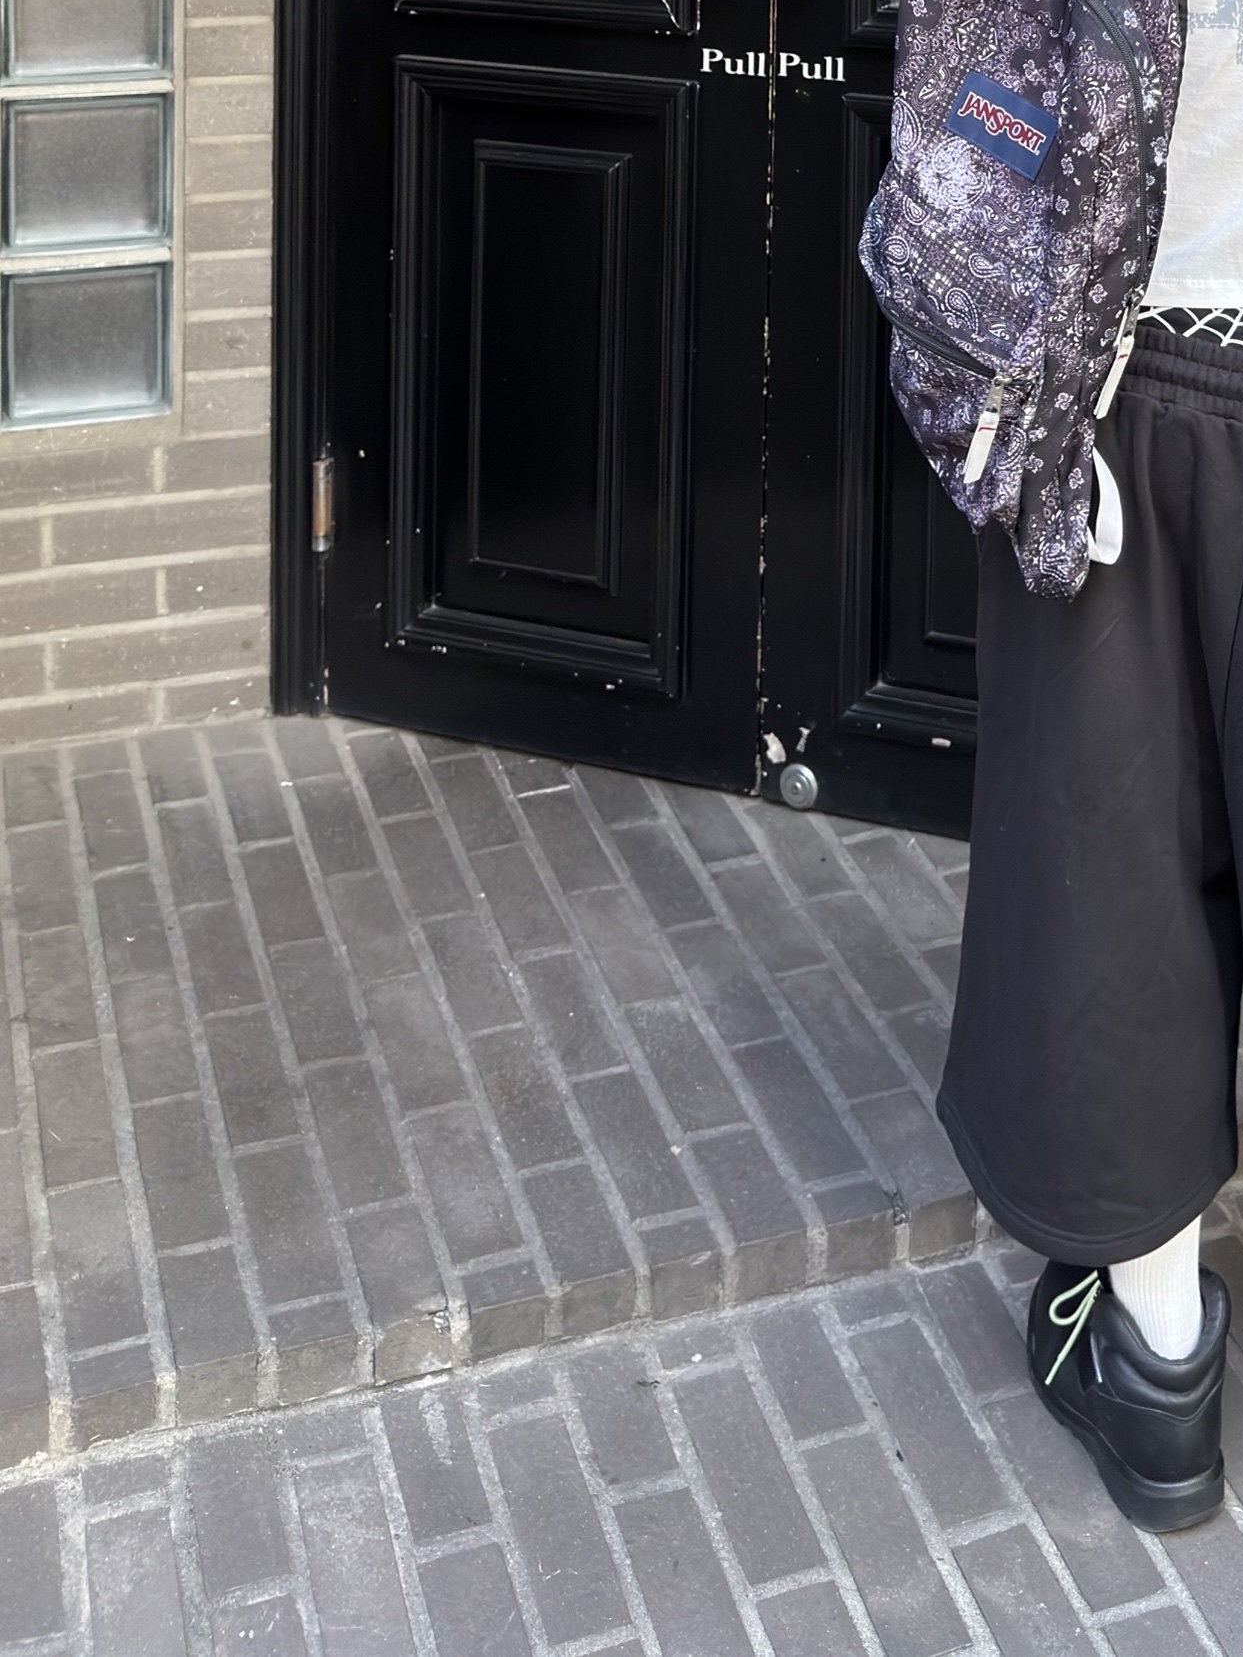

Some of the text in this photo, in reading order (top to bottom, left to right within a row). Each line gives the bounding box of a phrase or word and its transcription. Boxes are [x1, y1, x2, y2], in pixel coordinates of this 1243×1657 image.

[700, 48, 846, 82] Pull Pull
[957, 92, 1047, 153] JANSPORT
